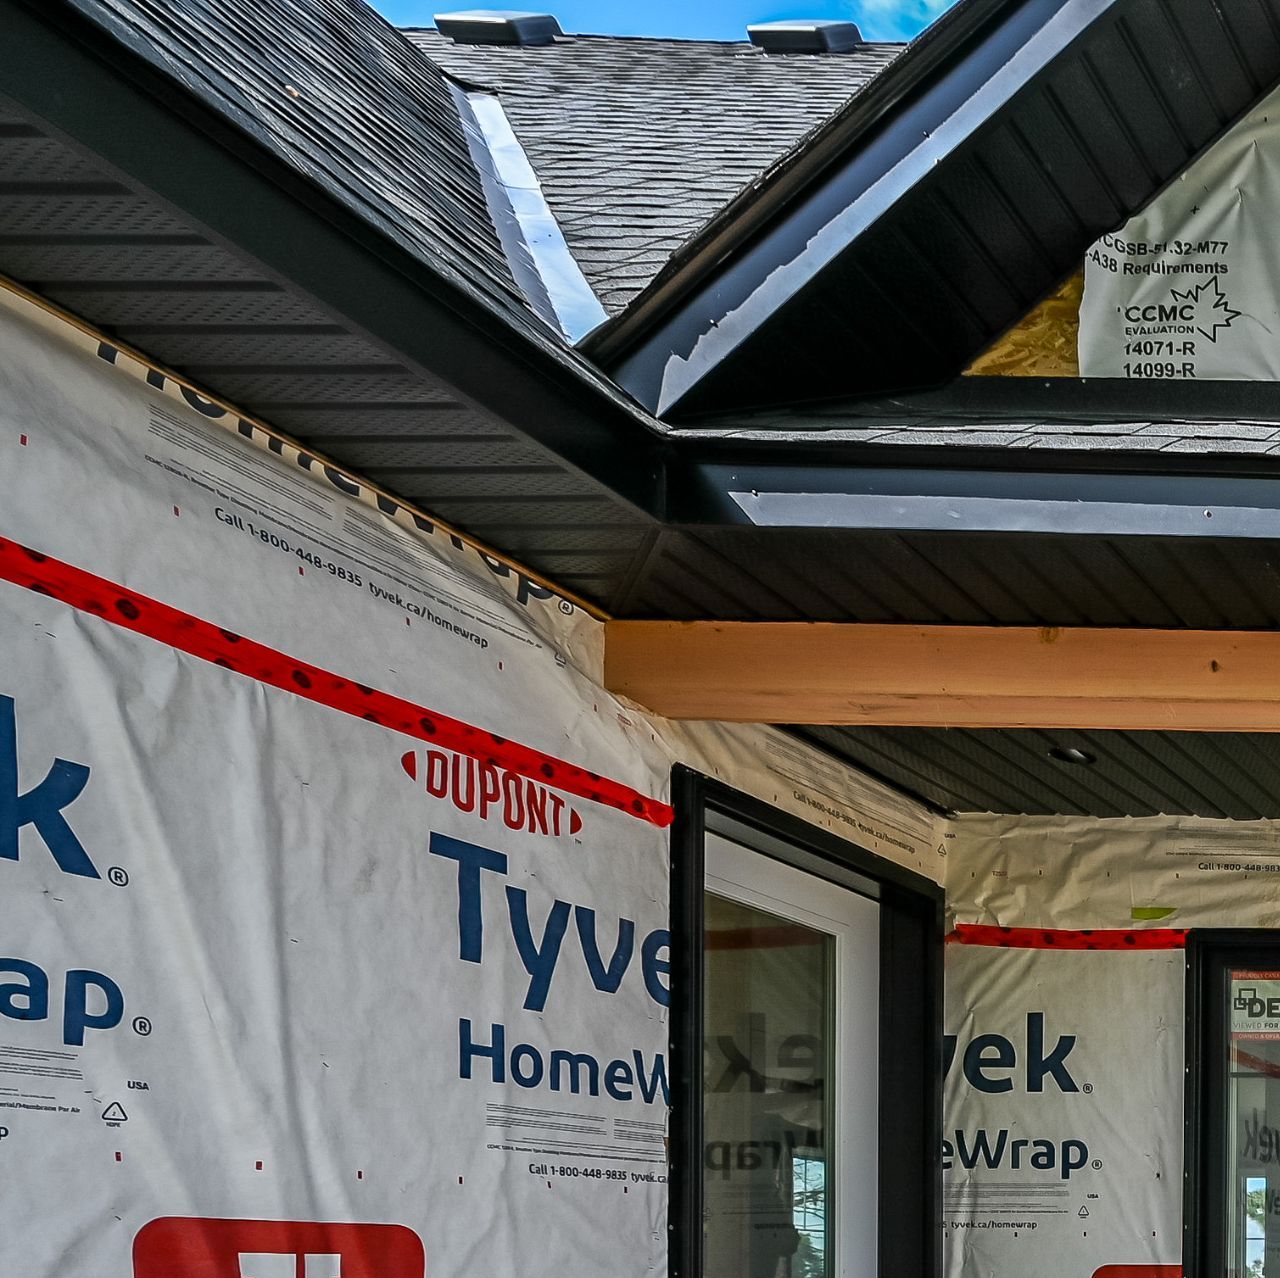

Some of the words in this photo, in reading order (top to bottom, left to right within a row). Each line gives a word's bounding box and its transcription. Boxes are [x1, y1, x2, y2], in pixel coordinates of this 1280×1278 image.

[1123, 260, 1229, 276] Requirements
[1124, 305, 1195, 323] CCMC
[1125, 326, 1195, 336] EVALUATION
[1124, 341, 1196, 356] 14071-R
[1123, 363, 1196, 378] 14099-R
[214, 506, 245, 532] Call
[247, 523, 363, 588] 1-800-448-9835
[368, 581, 489, 650] tyvek.ca/homewrap
[425, 749, 566, 837] DUPONT
[1198, 862, 1215, 871] Call
[127, 1080, 150, 1091] USA
[528, 1163, 548, 1176] Call
[551, 1165, 627, 1182] 1-800-448-9835
[951, 1220, 1038, 1229] tyvek.ca/homewrap
